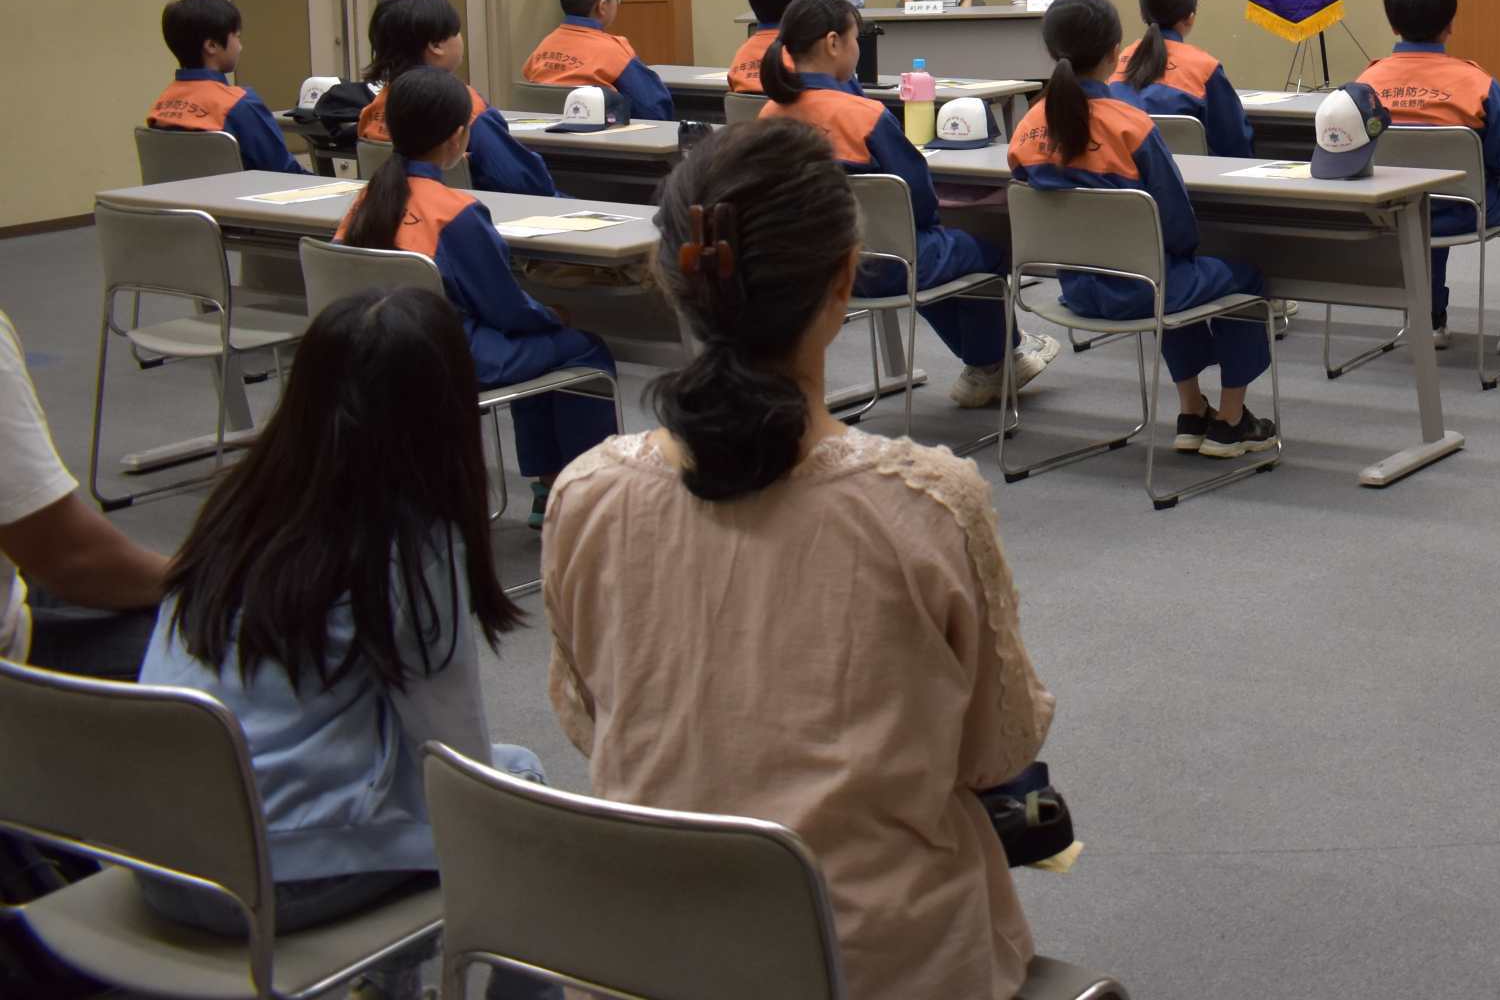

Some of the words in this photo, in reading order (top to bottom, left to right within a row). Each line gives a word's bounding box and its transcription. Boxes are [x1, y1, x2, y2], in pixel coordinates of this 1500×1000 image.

[1376, 86, 1452, 101] 年消防クラブ
